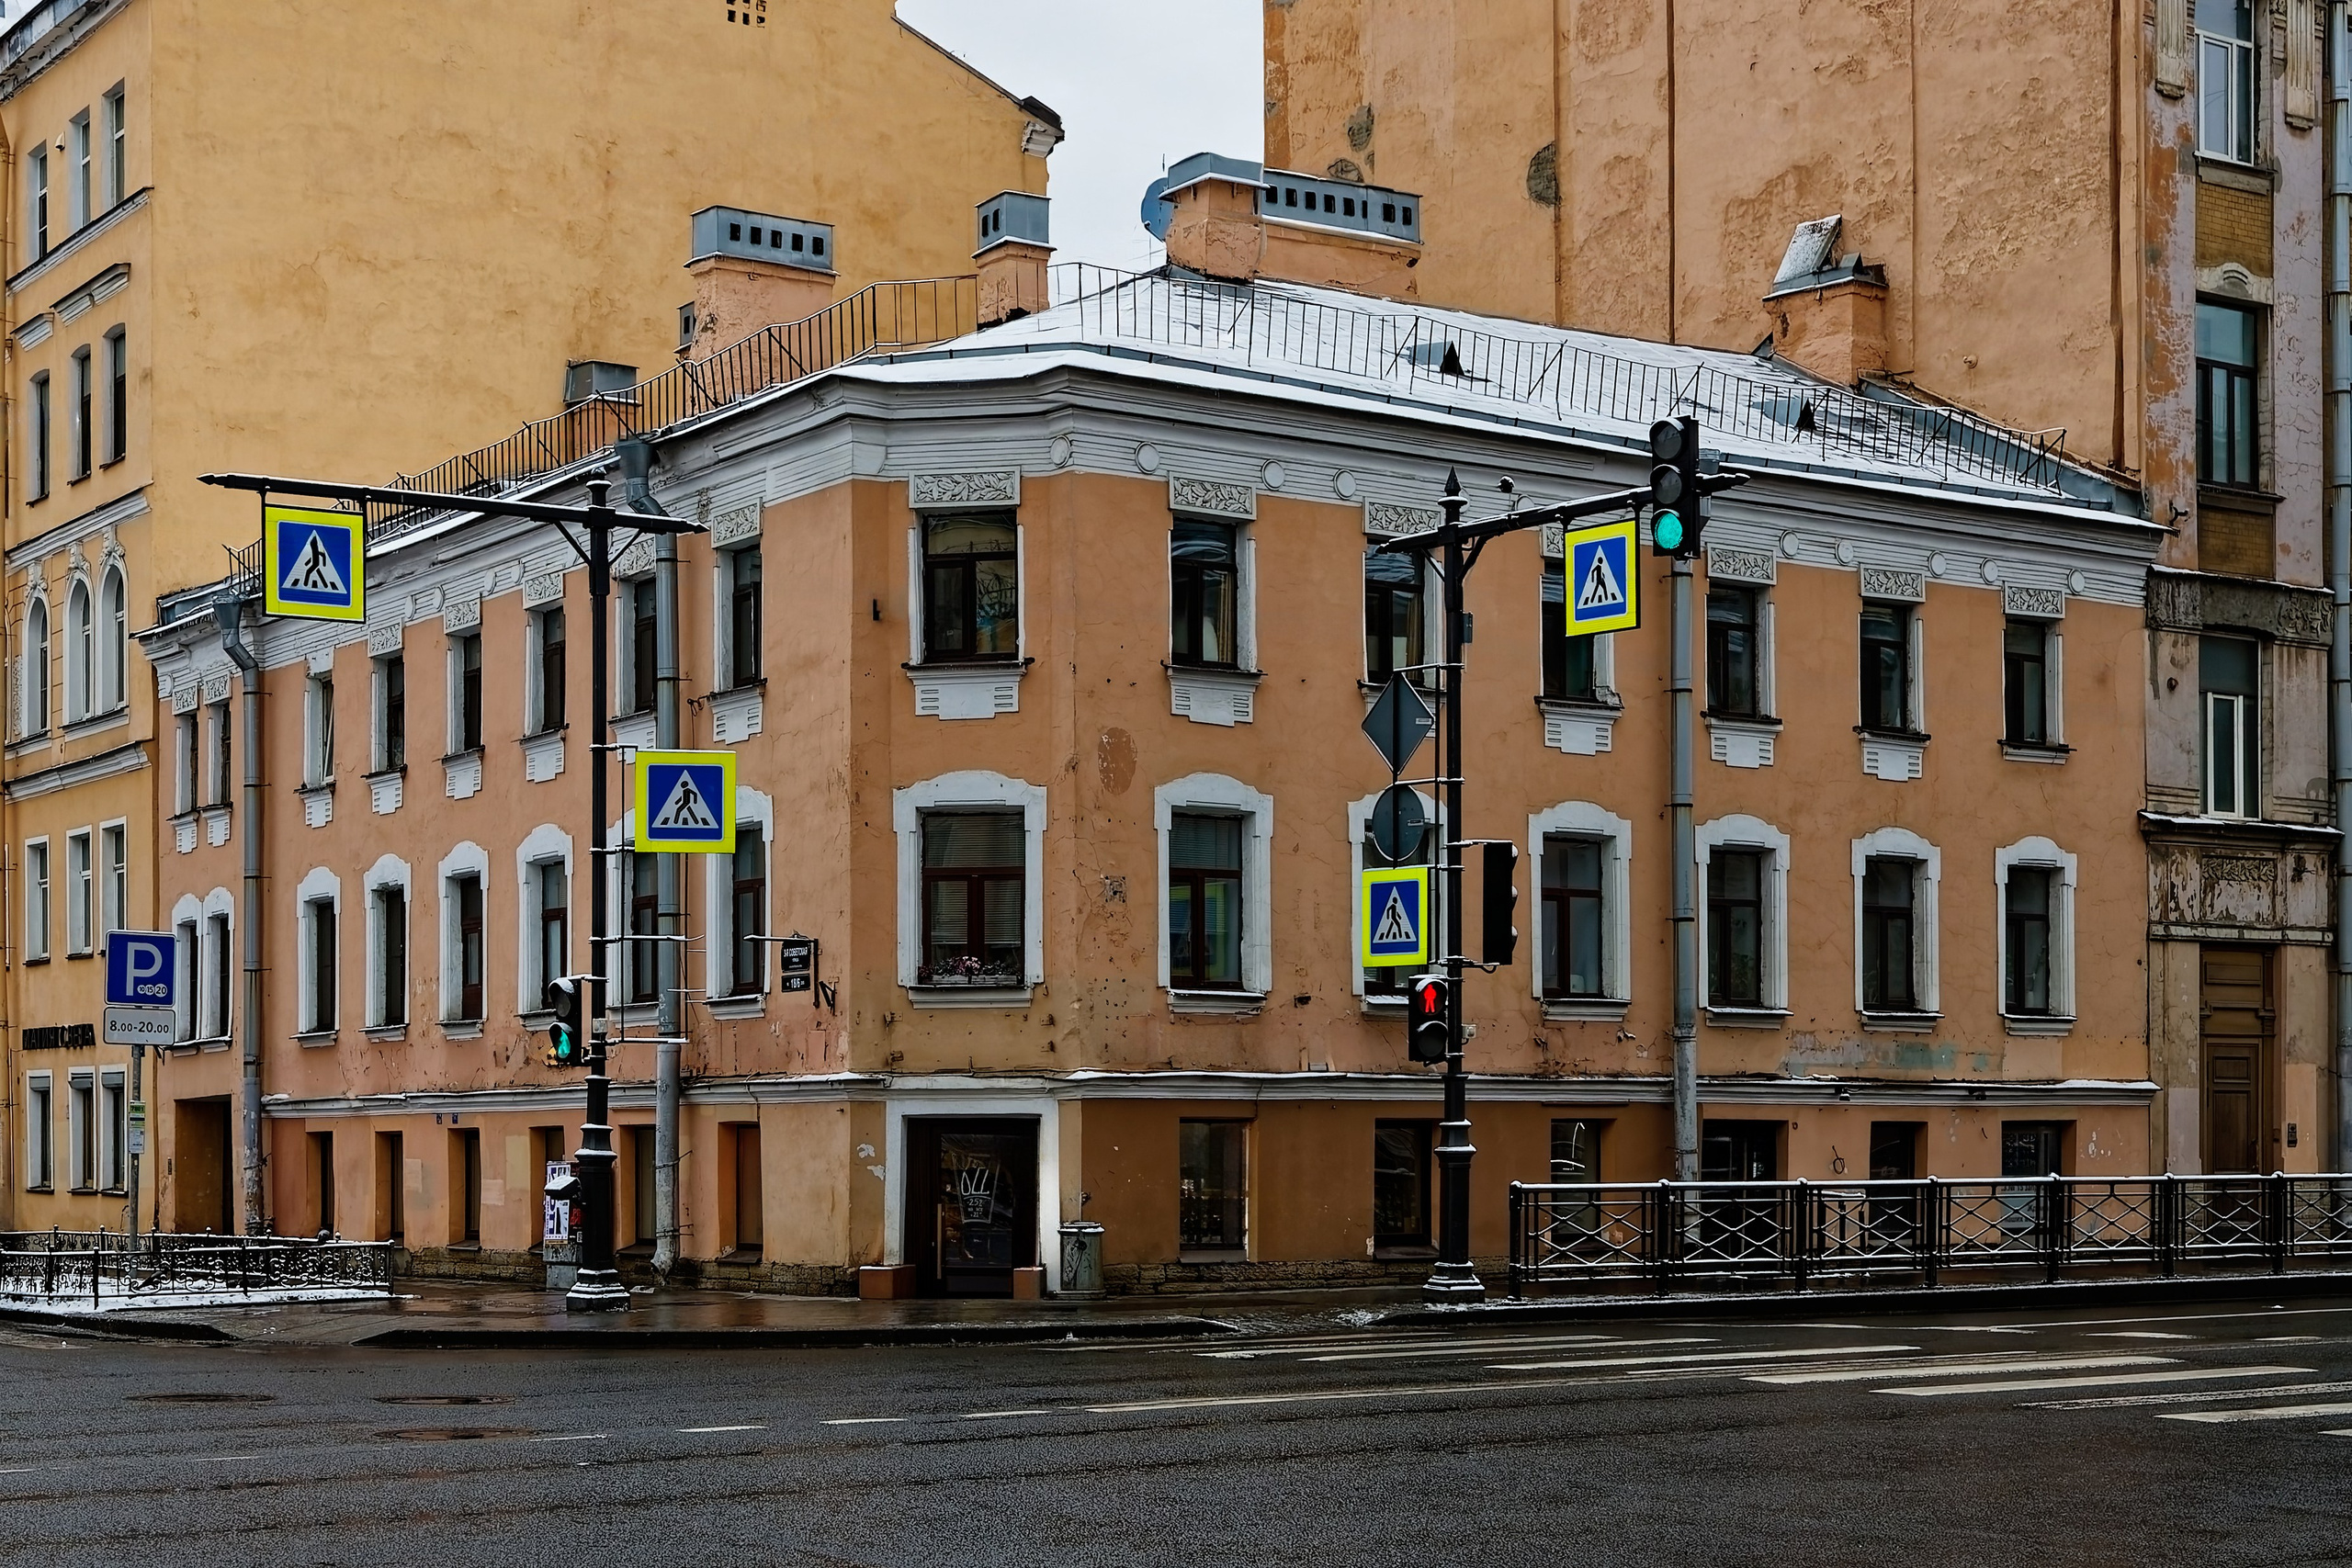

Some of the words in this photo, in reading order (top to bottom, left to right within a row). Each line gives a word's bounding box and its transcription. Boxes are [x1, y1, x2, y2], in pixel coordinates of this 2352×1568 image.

[126, 942, 163, 997] P
[139, 985, 146, 993] 10
[155, 986, 166, 995] 20
[109, 1020, 169, 1033] 8.00-20.00
